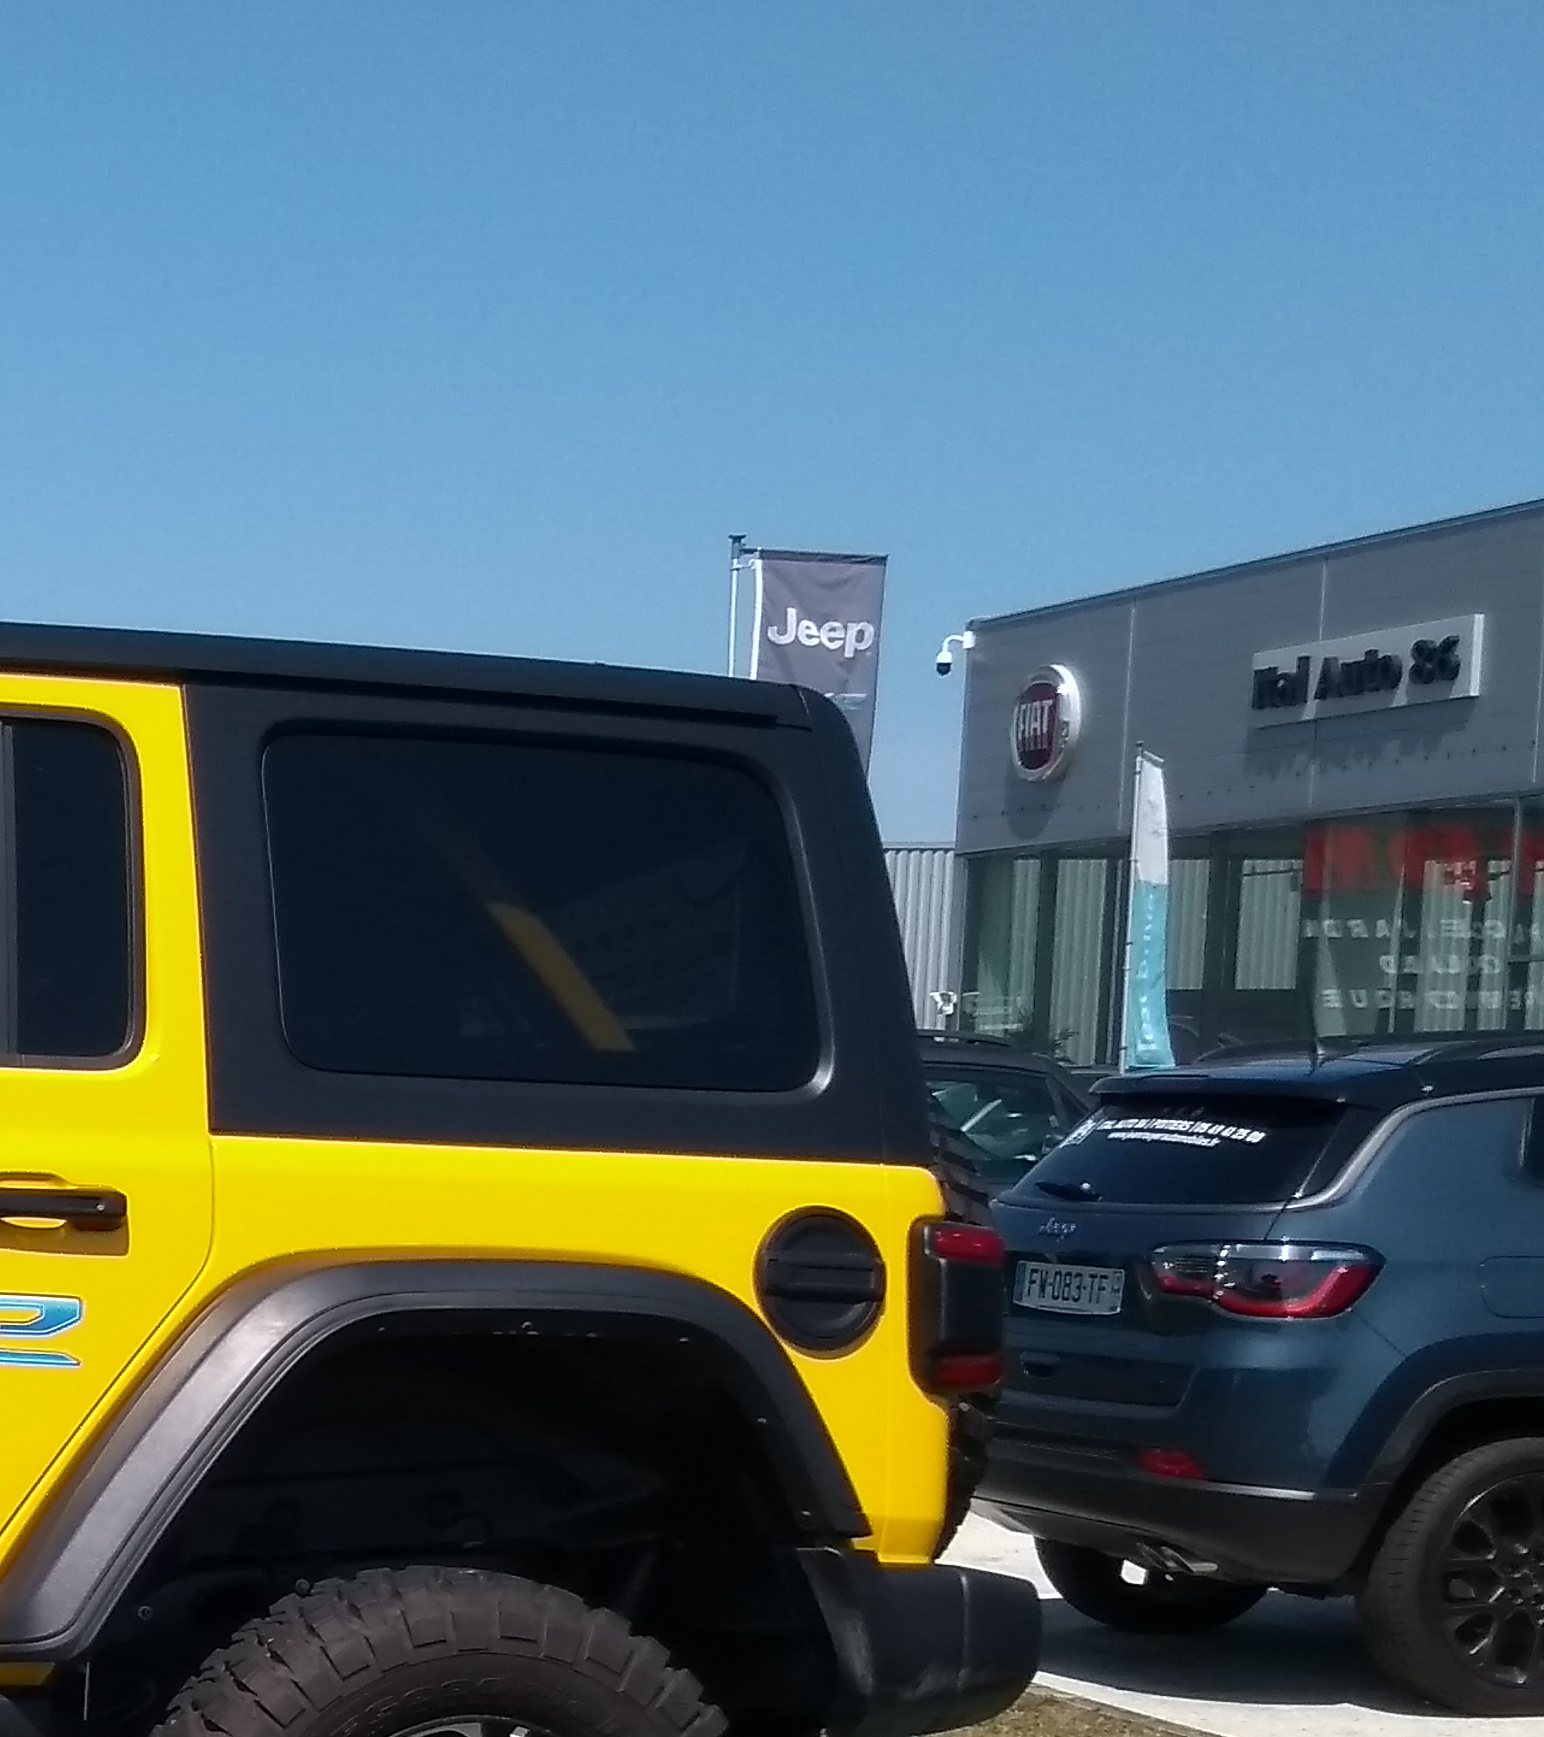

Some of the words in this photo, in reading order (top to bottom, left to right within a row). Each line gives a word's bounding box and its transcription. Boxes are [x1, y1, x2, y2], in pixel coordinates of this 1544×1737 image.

[767, 607, 875, 658] Jeep
[1409, 634, 1462, 684] 86
[1017, 699, 1054, 751] FIAT
